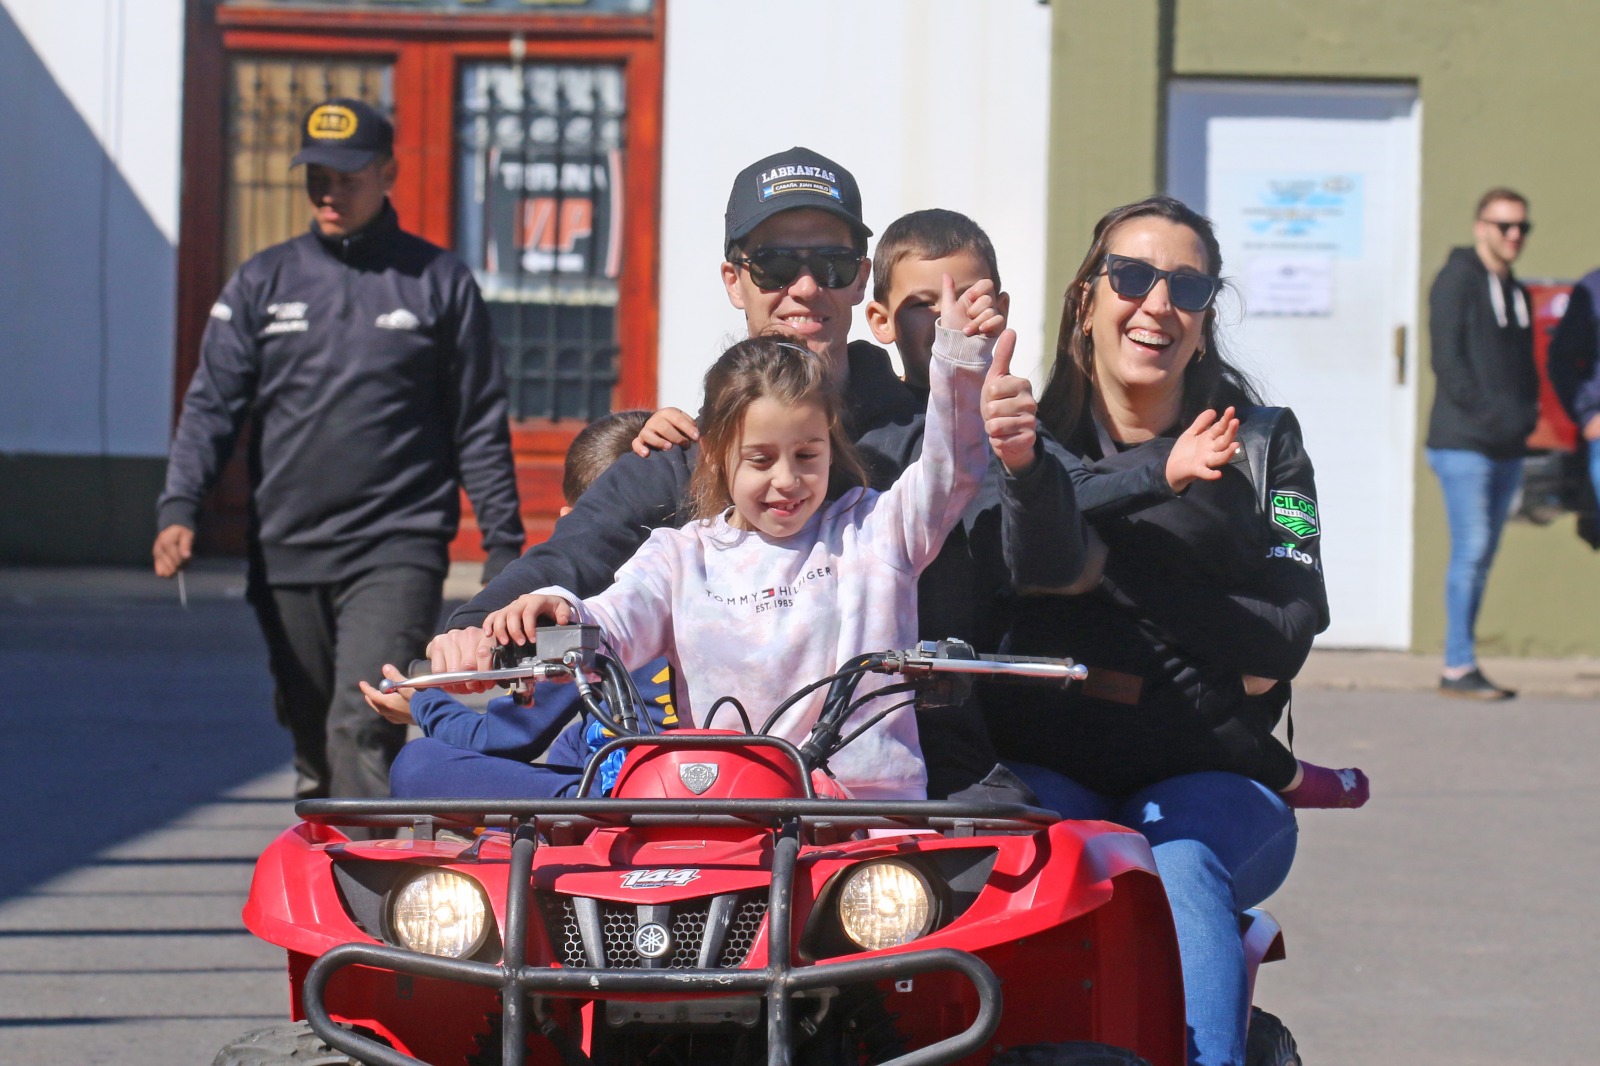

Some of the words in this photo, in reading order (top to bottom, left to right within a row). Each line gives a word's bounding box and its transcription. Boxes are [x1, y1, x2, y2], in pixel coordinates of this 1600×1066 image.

[761, 164, 836, 183] LABRANZAS
[1273, 495, 1315, 517] CILOS
[705, 588, 758, 606] TOMMY
[755, 602, 772, 613] EST.
[774, 599, 794, 608] 1985
[621, 868, 699, 888] 144
